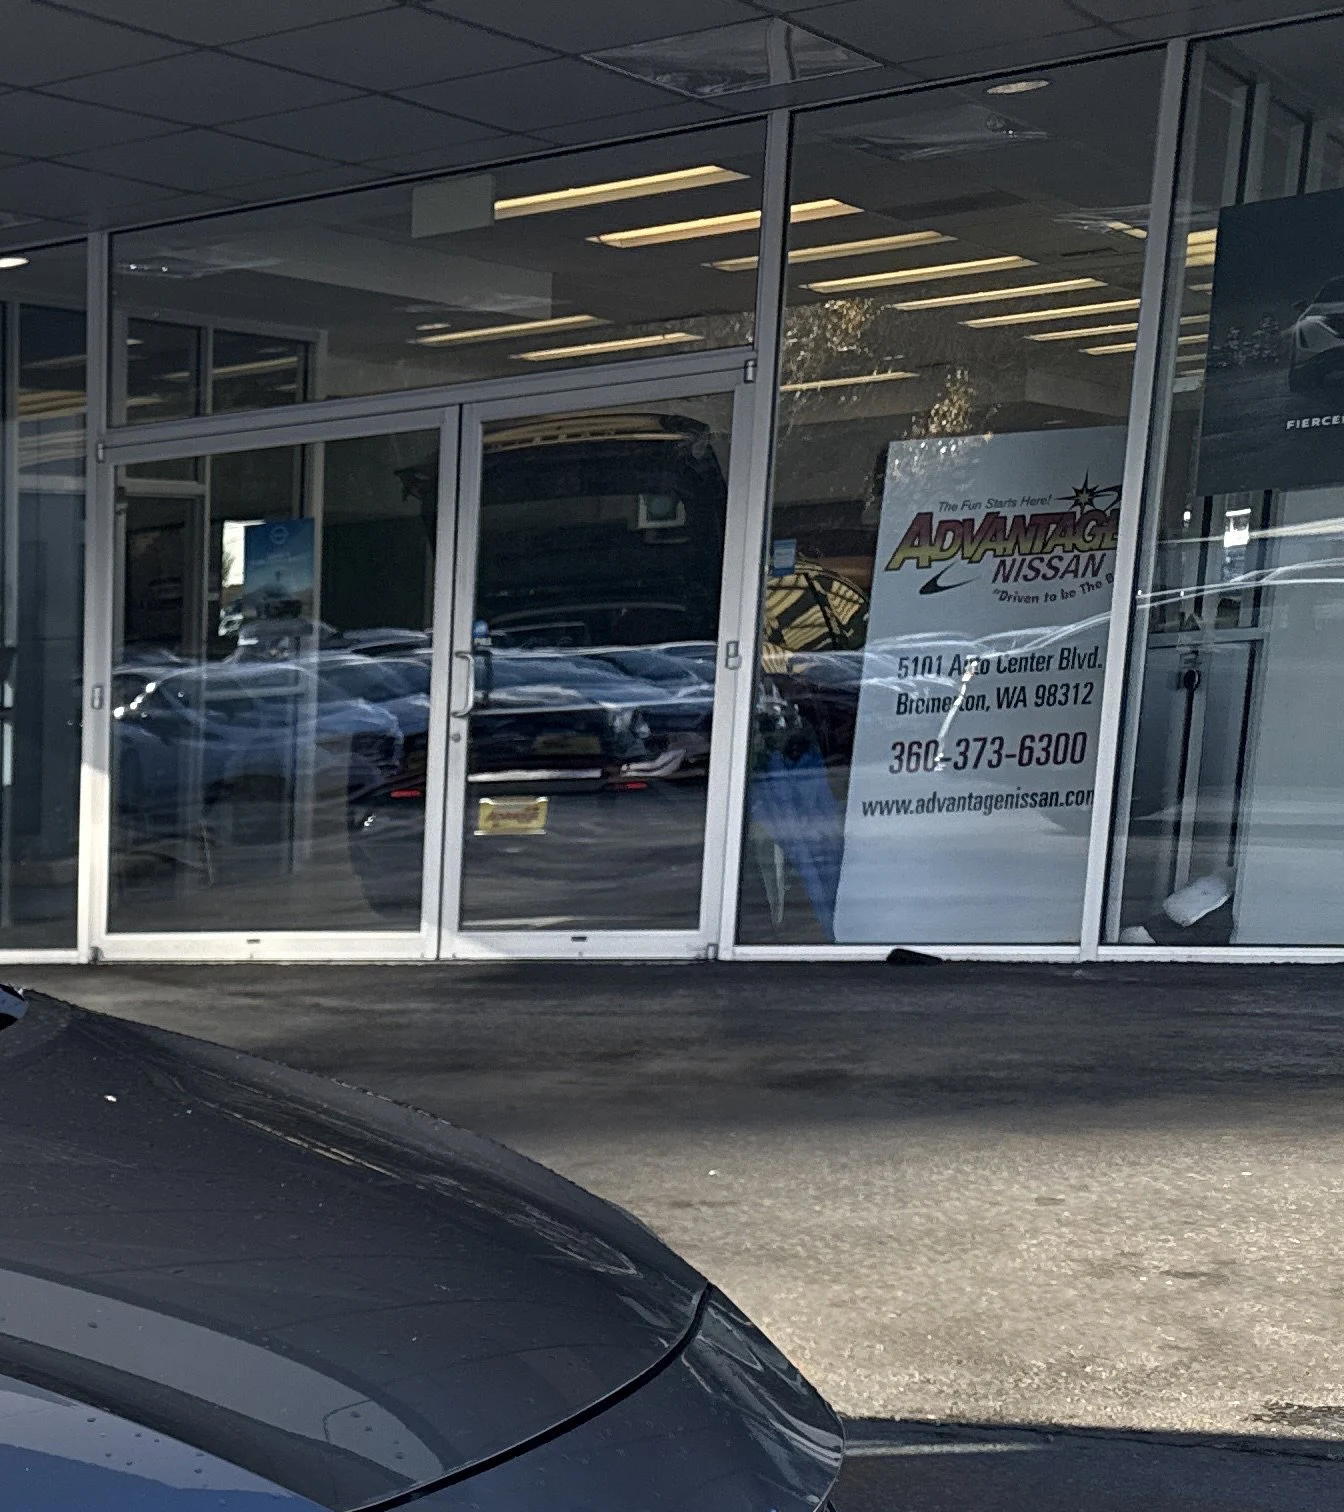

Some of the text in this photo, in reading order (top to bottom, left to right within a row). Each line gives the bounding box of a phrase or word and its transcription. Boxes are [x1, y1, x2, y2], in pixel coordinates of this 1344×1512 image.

[938, 494, 1053, 513] The Fun Starts Here!
[991, 553, 1107, 584] NISSAN
[992, 589, 1040, 604] "Driven
[1043, 591, 1058, 604] to
[1060, 587, 1077, 601] be
[1079, 580, 1103, 595] The
[897, 654, 943, 679] 5101
[996, 652, 1053, 675] Center
[1057, 646, 1103, 671] Blvd.
[996, 685, 1028, 710] WA
[1034, 682, 1095, 708] 98312
[888, 731, 1088, 775] 360-373-6300
